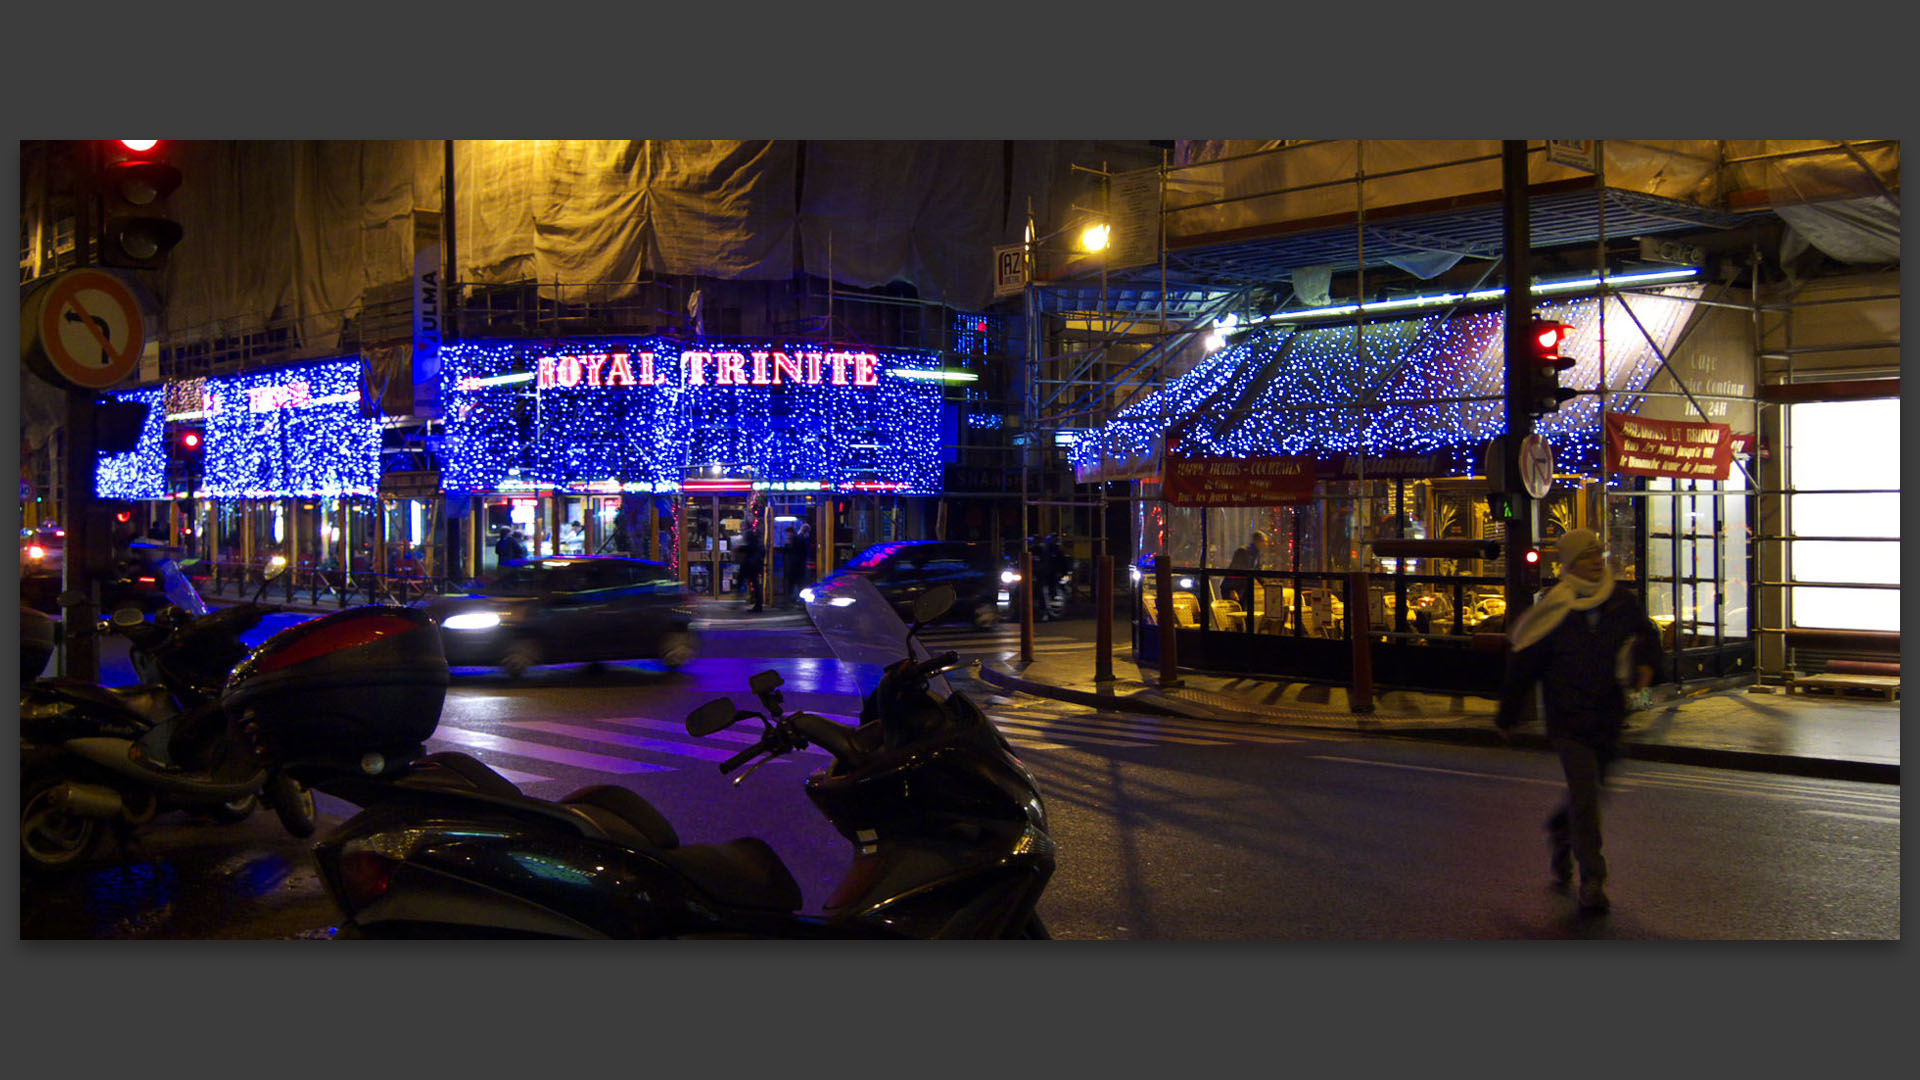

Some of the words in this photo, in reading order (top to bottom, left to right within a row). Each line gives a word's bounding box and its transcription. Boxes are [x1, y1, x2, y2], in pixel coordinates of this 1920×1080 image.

[1004, 252, 1020, 275] AZ
[538, 353, 666, 389] ROYAL
[681, 351, 880, 386] TRINITE
